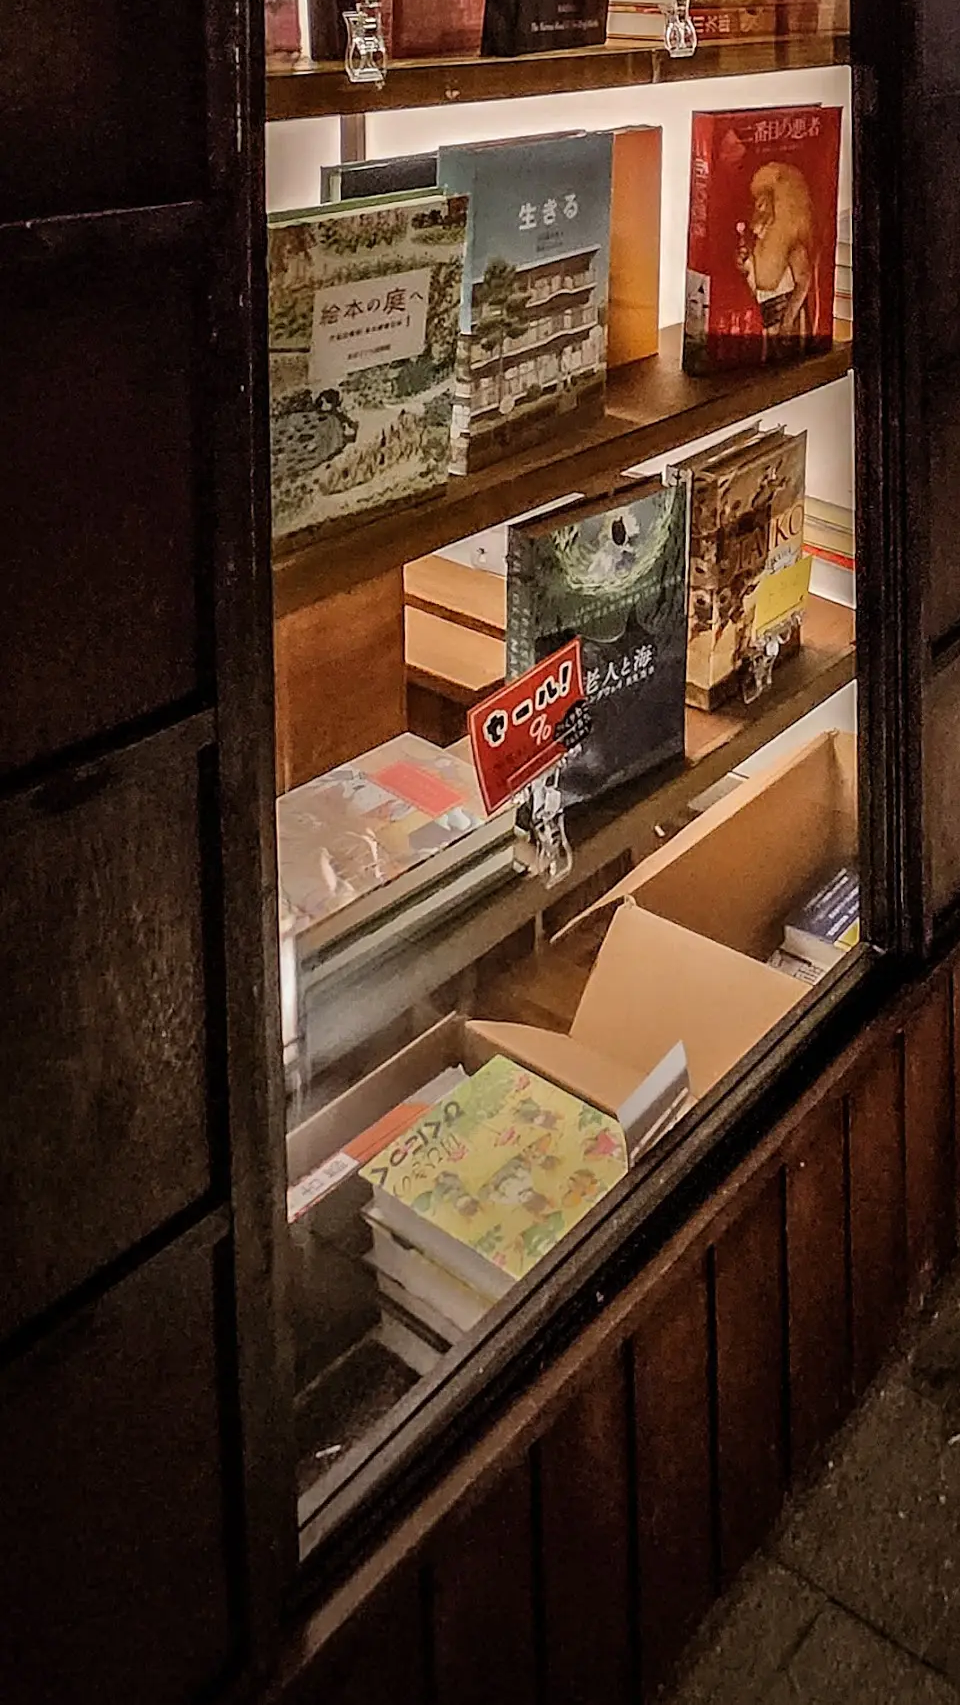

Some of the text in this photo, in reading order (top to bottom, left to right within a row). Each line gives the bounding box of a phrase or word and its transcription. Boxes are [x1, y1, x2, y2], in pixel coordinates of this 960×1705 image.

[518, 192, 579, 231] 生きる
[319, 287, 424, 327] 絵本の庭へ
[583, 643, 653, 696] 老人と海
